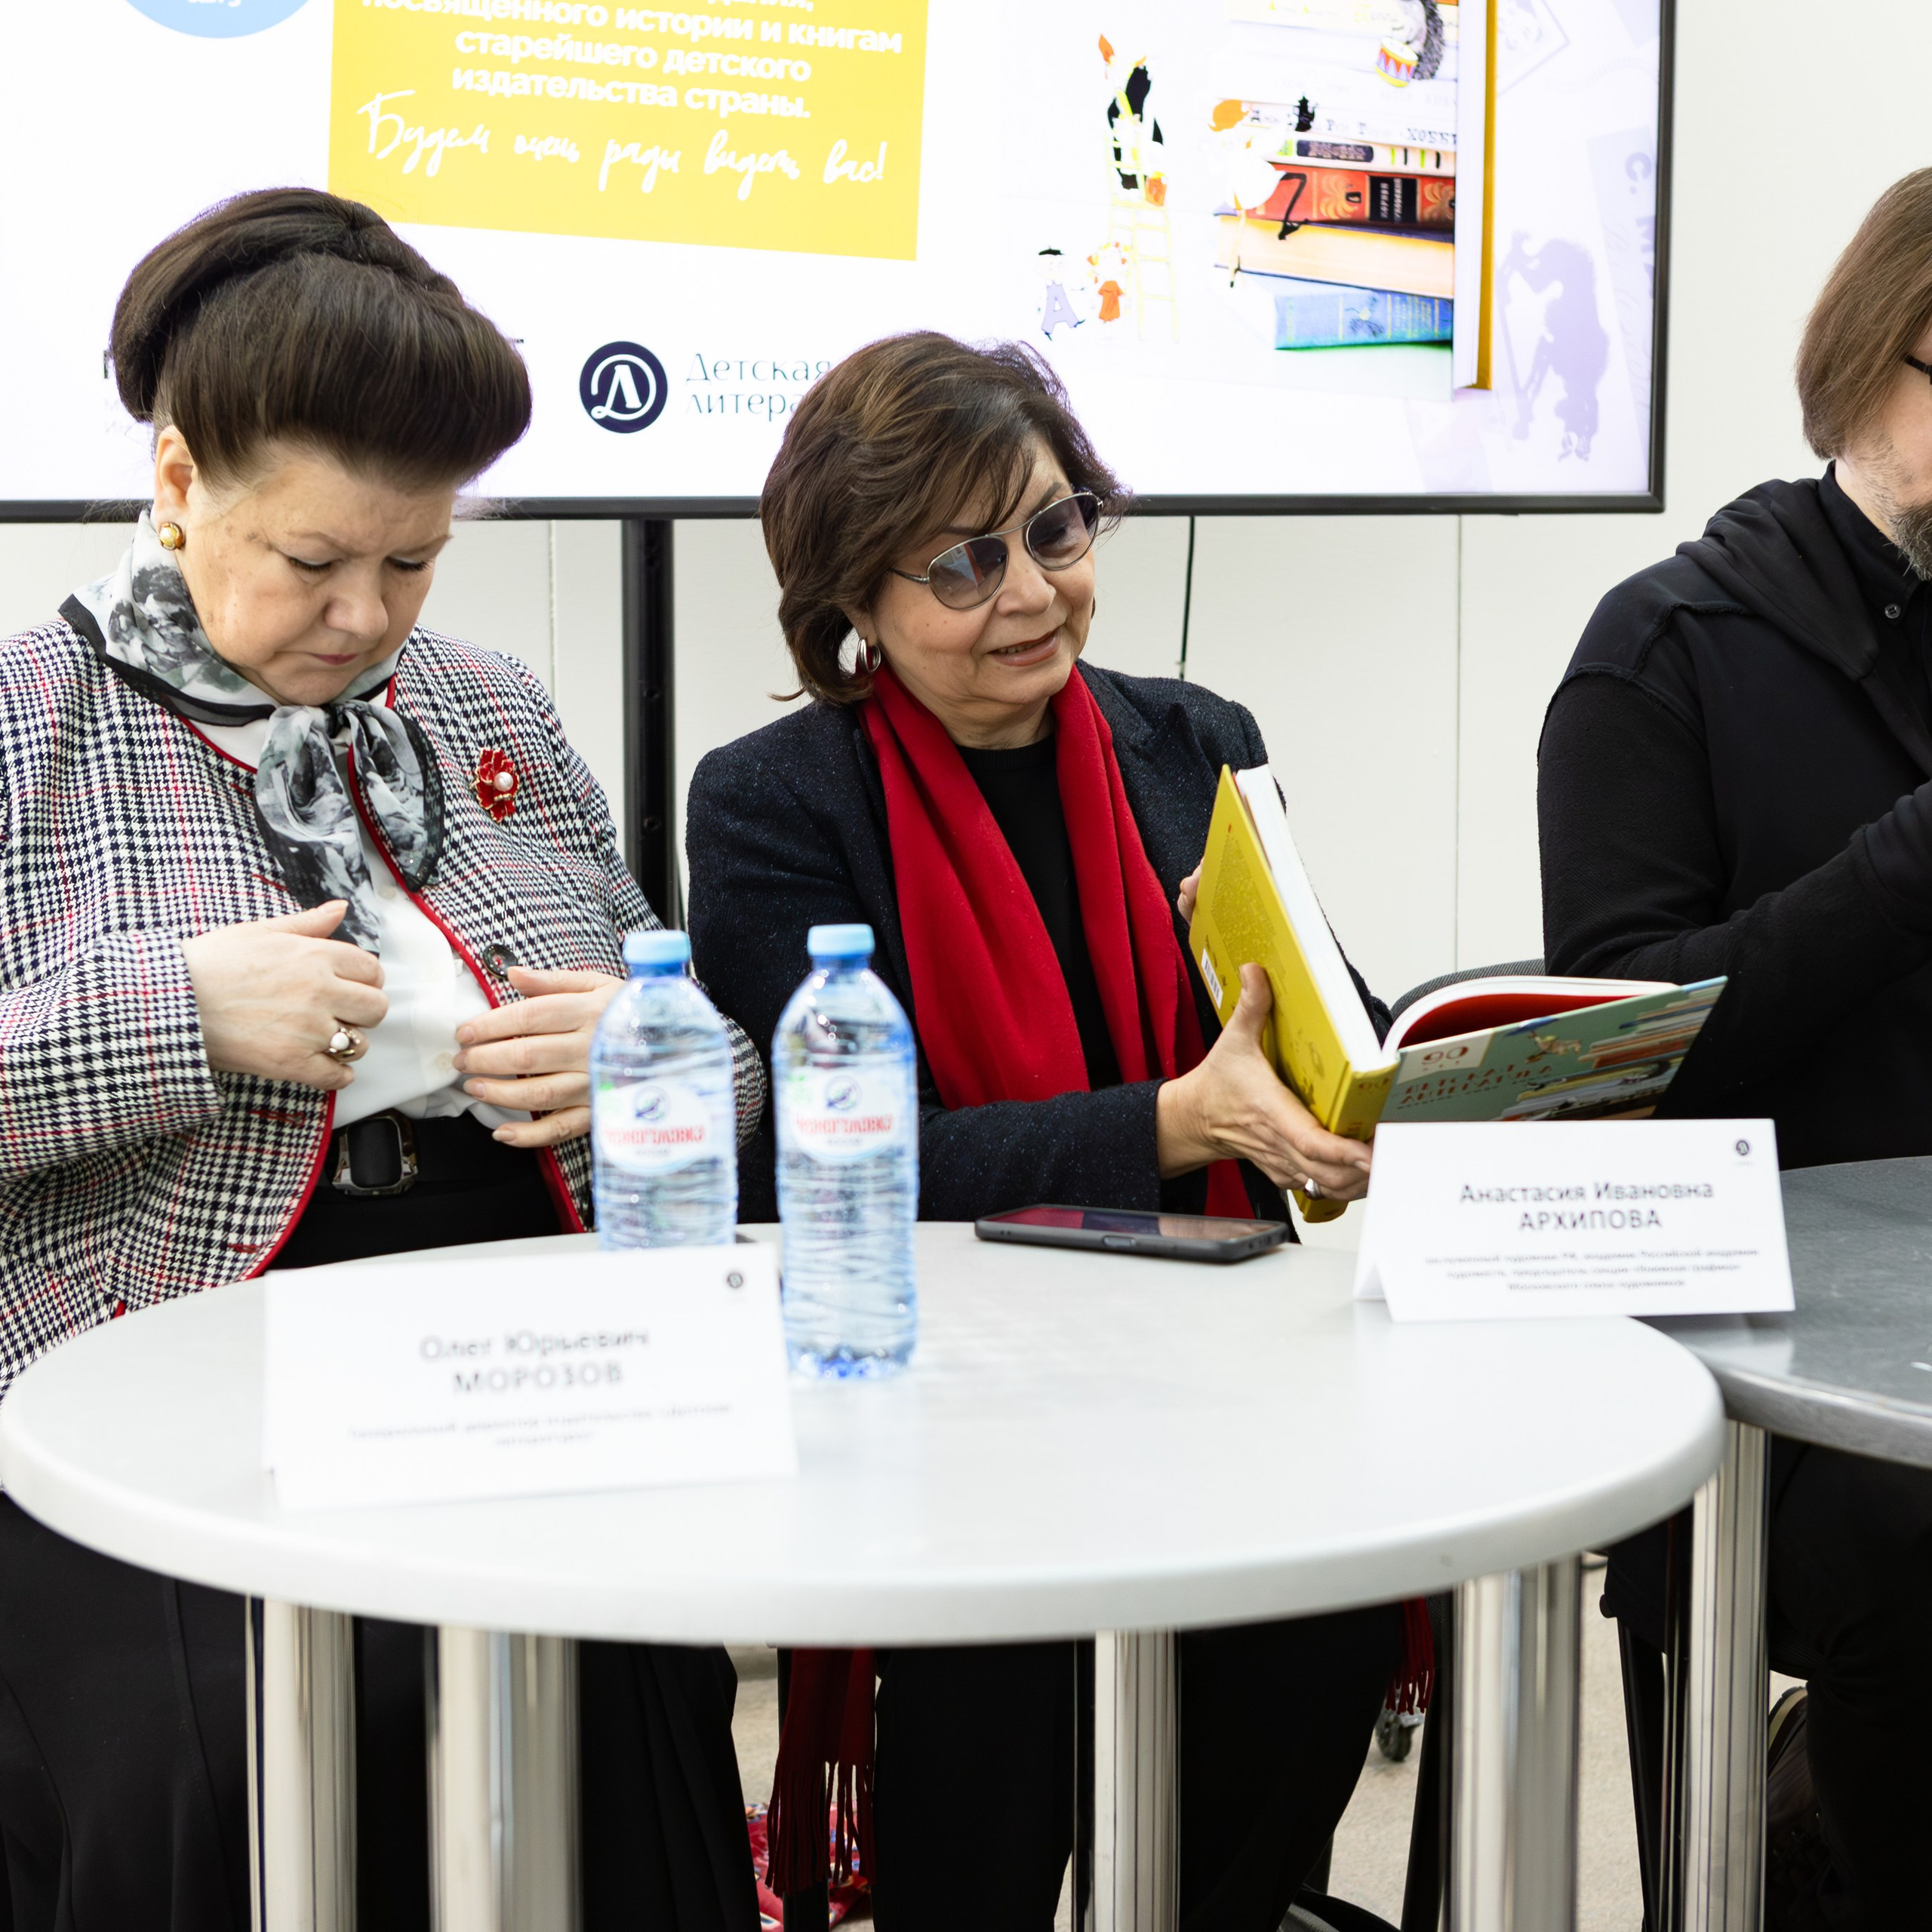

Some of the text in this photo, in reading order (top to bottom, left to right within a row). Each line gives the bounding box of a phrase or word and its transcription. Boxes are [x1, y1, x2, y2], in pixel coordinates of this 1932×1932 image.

[616, 8, 754, 43] истории
[760, 20, 782, 44] и
[789, 23, 903, 54] книгам
[455, 30, 812, 82] старейшего детского
[452, 68, 811, 118] издательства страны.
[356, 89, 491, 177] Будем
[598, 139, 681, 194] рады
[703, 129, 801, 201] видеть
[823, 139, 888, 184] вас!
[685, 352, 831, 383] Детская
[1460, 1182, 1714, 1204] Анастасия Ивановна
[1518, 1210, 1663, 1230] АРХИПОВА
[420, 1334, 494, 1361] Олег
[453, 1362, 624, 1393] МОРОЗОВ
